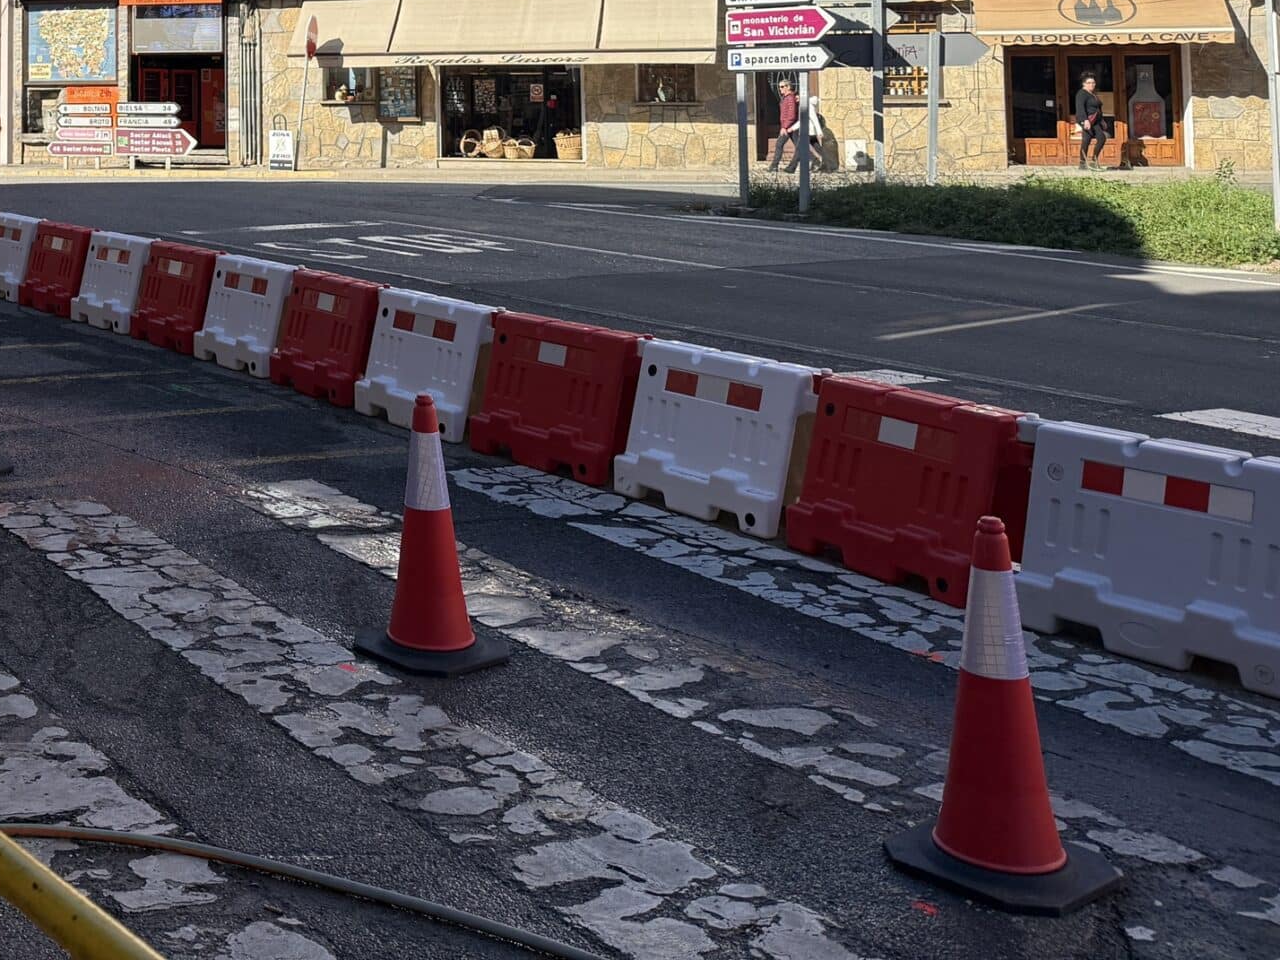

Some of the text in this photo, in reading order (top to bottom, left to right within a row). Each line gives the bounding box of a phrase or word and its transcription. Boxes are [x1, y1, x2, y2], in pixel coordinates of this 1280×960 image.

[743, 14, 804, 24] monasterio de
[743, 24, 815, 37] San Victorián
[1001, 33, 1210, 43] LA BODEGA LA CAVE
[744, 53, 817, 67] aparcamiento
[255, 233, 515, 259] STOP
